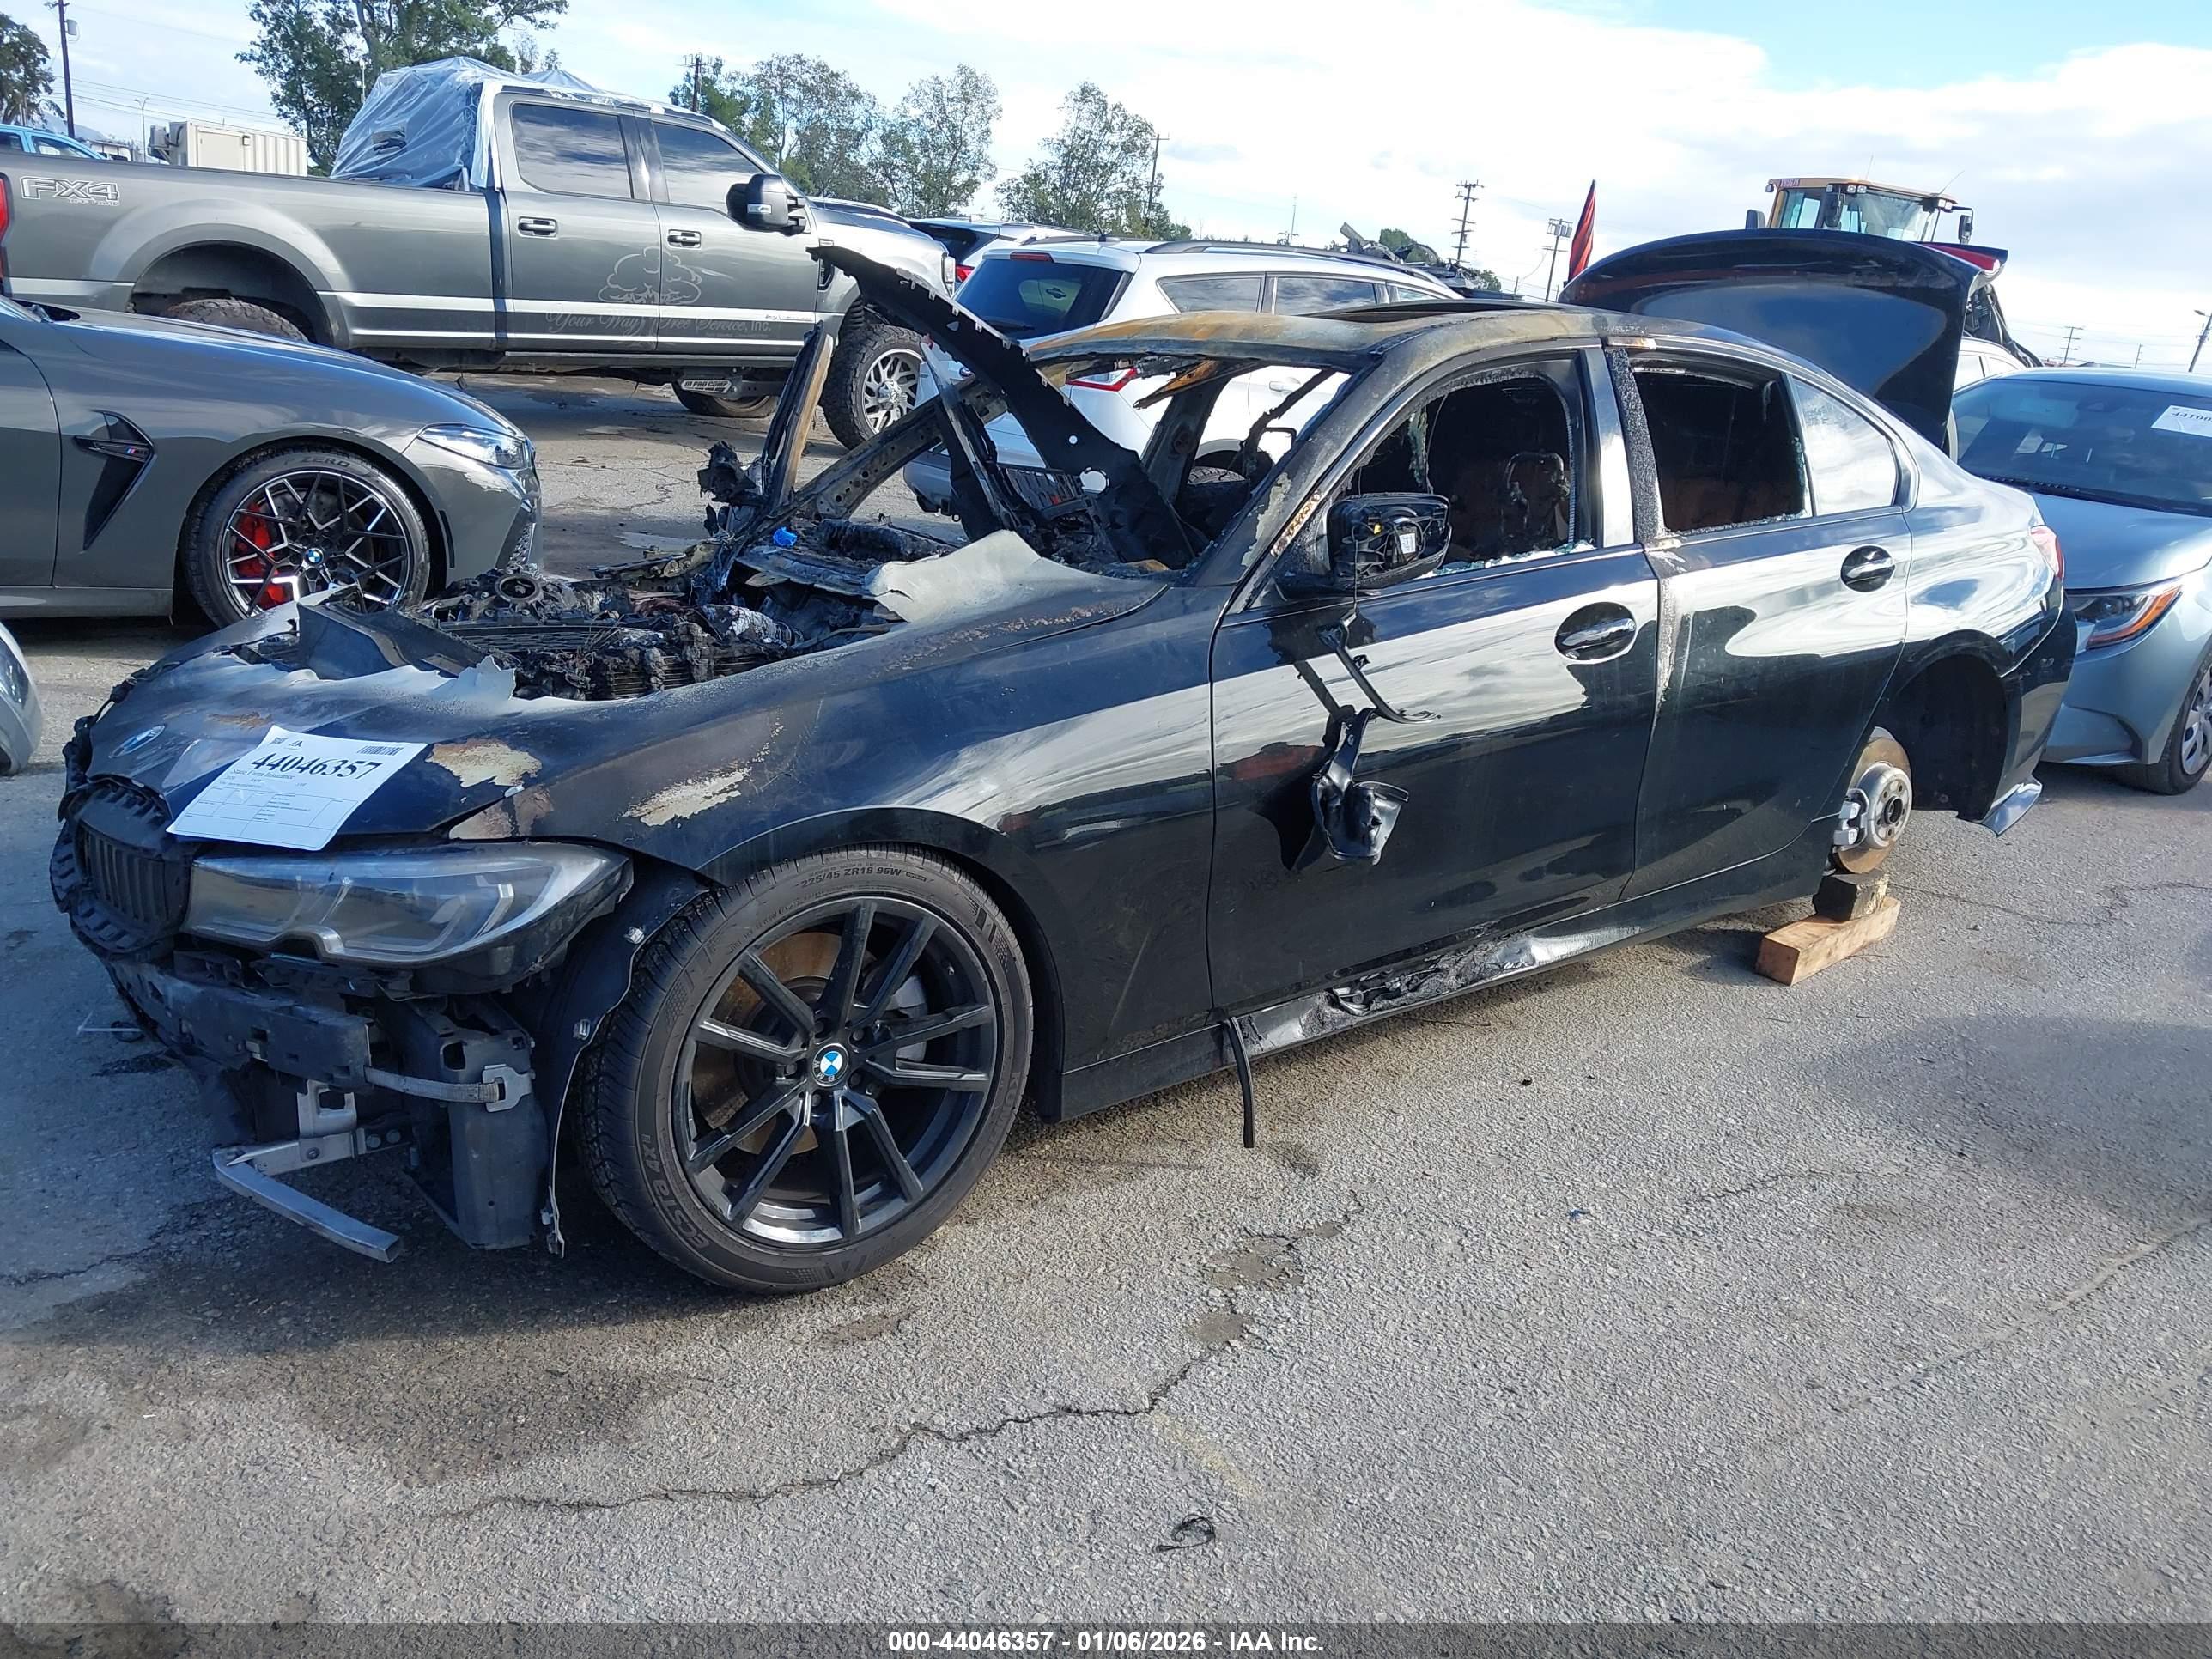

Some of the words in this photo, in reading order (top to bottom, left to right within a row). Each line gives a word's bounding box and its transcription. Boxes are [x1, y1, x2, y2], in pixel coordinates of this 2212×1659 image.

[20, 176, 119, 202] FX4
[545, 312, 594, 333] Your
[599, 313, 645, 336] Way
[750, 319, 771, 331] Inc.
[252, 752, 383, 780] 44046357
[844, 866, 873, 876] ZR18
[876, 866, 902, 876] 95W
